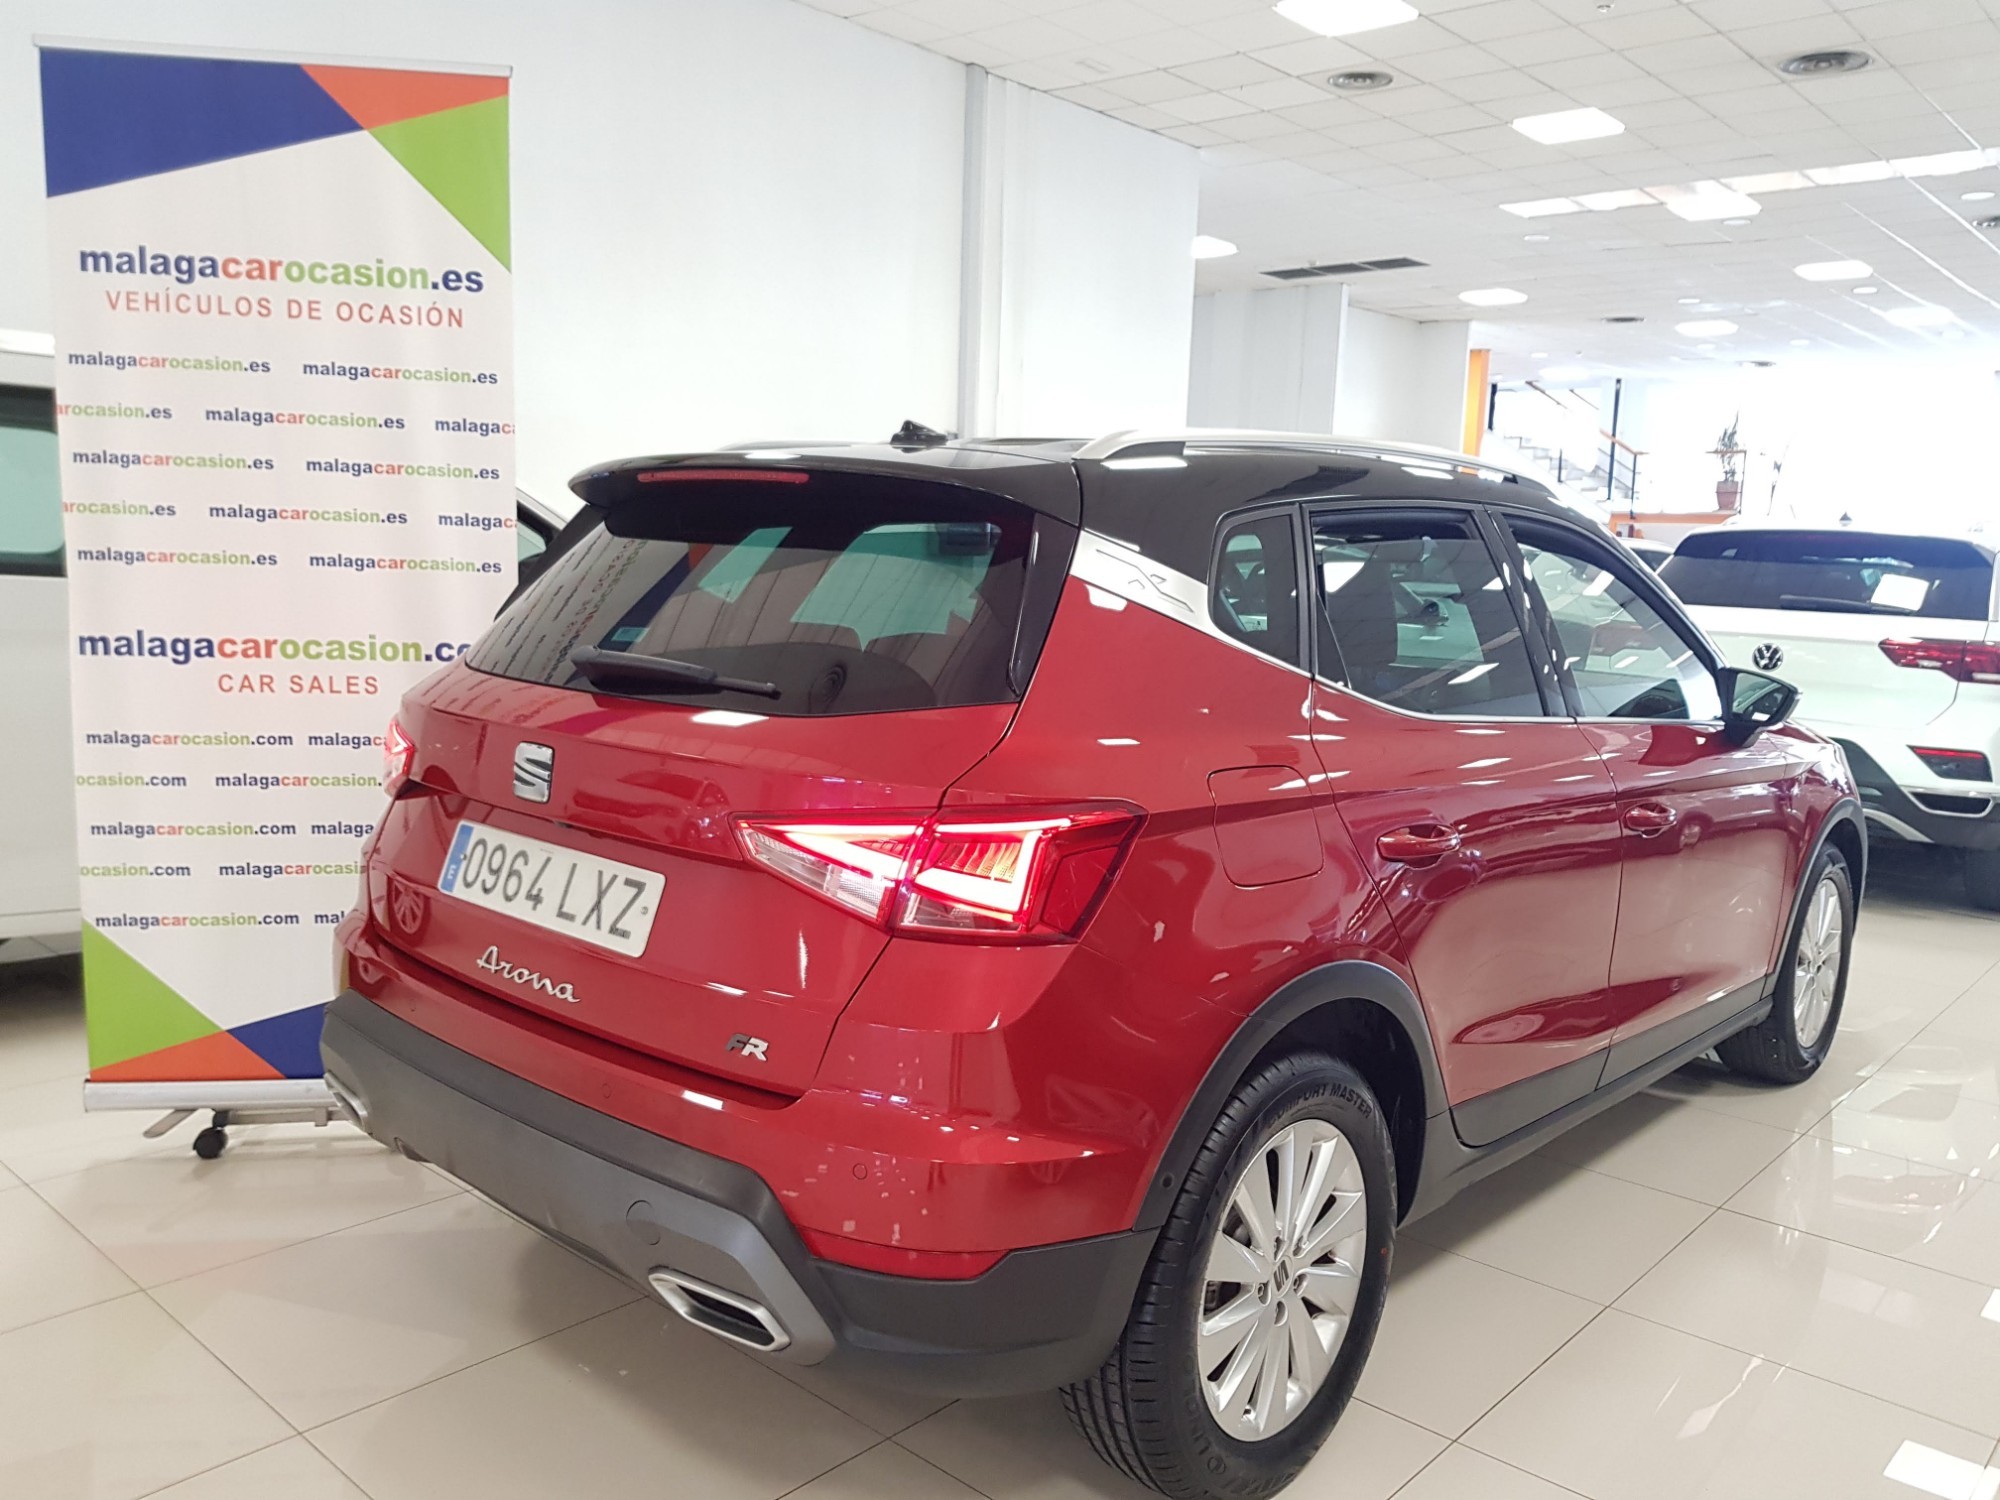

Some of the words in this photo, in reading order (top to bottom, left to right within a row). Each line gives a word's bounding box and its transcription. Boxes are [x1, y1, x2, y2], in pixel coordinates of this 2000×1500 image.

[80, 246, 483, 292] malagacarocasion.es
[106, 289, 271, 318] VEHÍCULOS
[288, 299, 322, 321] DE
[336, 302, 464, 328] OCASIÓN
[69, 352, 270, 373] malagacarocasion.es
[303, 361, 497, 384] malagacarocasion.es
[206, 407, 405, 430] malagacarocasion.es
[73, 450, 273, 471] malagacarocasion.es
[306, 458, 500, 480] malagacarocasion.es
[209, 504, 407, 524] malagacarocasion.es
[78, 547, 277, 566] malagacarocasion.es
[310, 554, 502, 574] malagacarocasion.es
[218, 674, 275, 693] CAR
[290, 675, 379, 694] SALES
[86, 731, 293, 747] malagacarocasion.com
[76, 773, 186, 787] ocasion.com
[91, 821, 296, 839] malagacarocasion.com
[80, 863, 191, 877] ocasion.com
[462, 838, 552, 911] 0964
[556, 862, 647, 940] LXZ
[96, 912, 299, 931] malagacarocasion.com
[476, 945, 581, 1003] Arona
[726, 1033, 770, 1062] FR
[1329, 1082, 1373, 1119] MASTER
